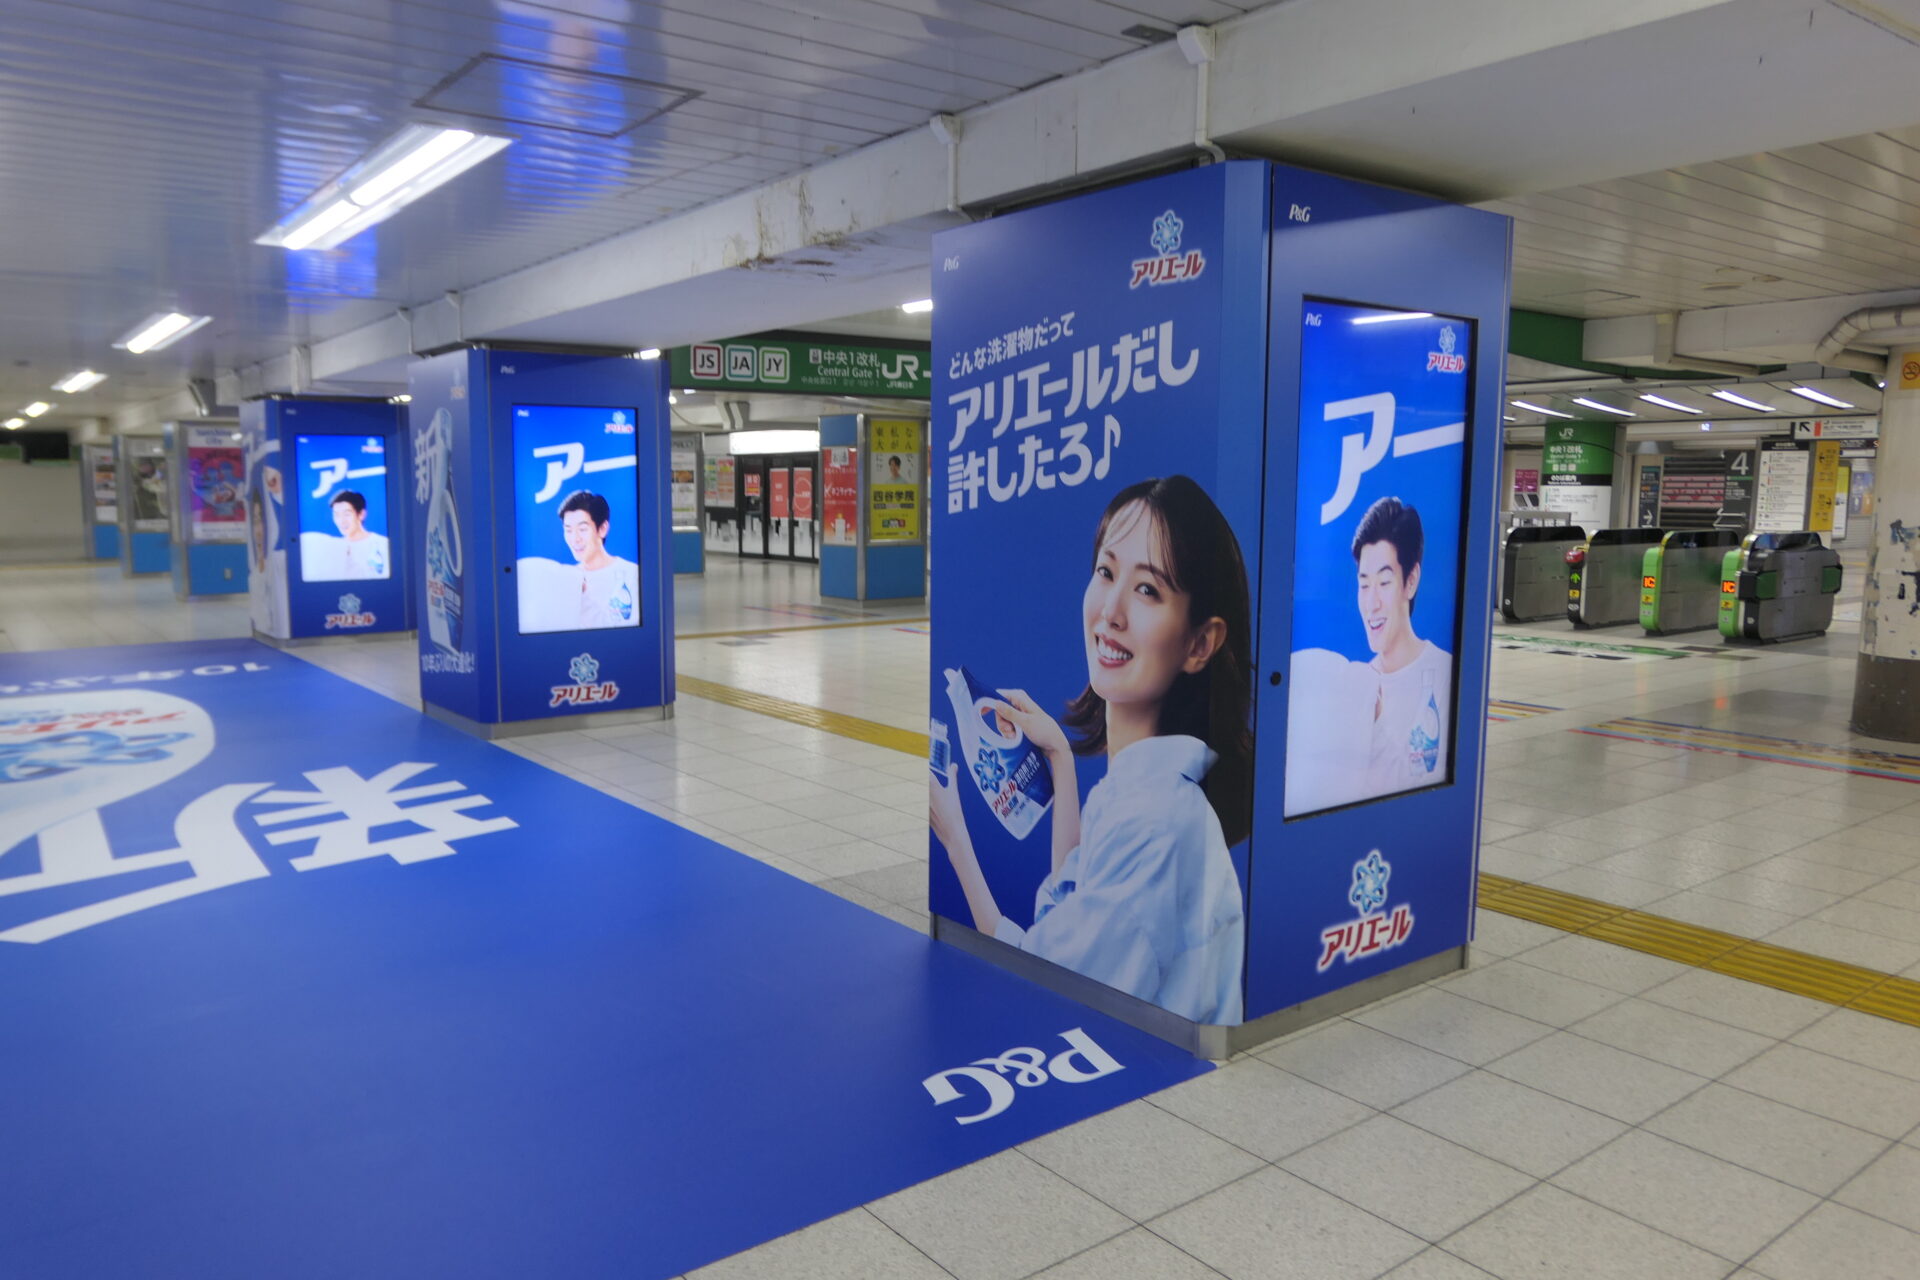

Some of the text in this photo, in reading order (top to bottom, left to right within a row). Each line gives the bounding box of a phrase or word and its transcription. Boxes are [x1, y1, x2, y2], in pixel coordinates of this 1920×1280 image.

[1289, 203, 1311, 223] P&G
[1130, 251, 1205, 288] アリエール
[1305, 313, 1322, 327] P&G
[949, 311, 1075, 379] どんな洗濯物だって
[699, 353, 715, 369] JS
[732, 355, 751, 371] JA
[766, 358, 782, 373] JY
[817, 365, 849, 378] Central
[852, 367, 873, 379] Gate
[881, 354, 919, 380] JR
[1427, 351, 1465, 373] アリエール
[948, 320, 1199, 452] アリエールだし
[1320, 391, 1465, 526] アー
[1731, 452, 1749, 476] 4
[309, 458, 387, 499] アー
[533, 442, 637, 504] アー
[1644, 577, 1656, 588] IC
[1723, 581, 1736, 593] IC
[550, 681, 620, 708] アリエール
[1318, 905, 1415, 972] アリエール
[922, 1027, 1125, 1126] P&G
